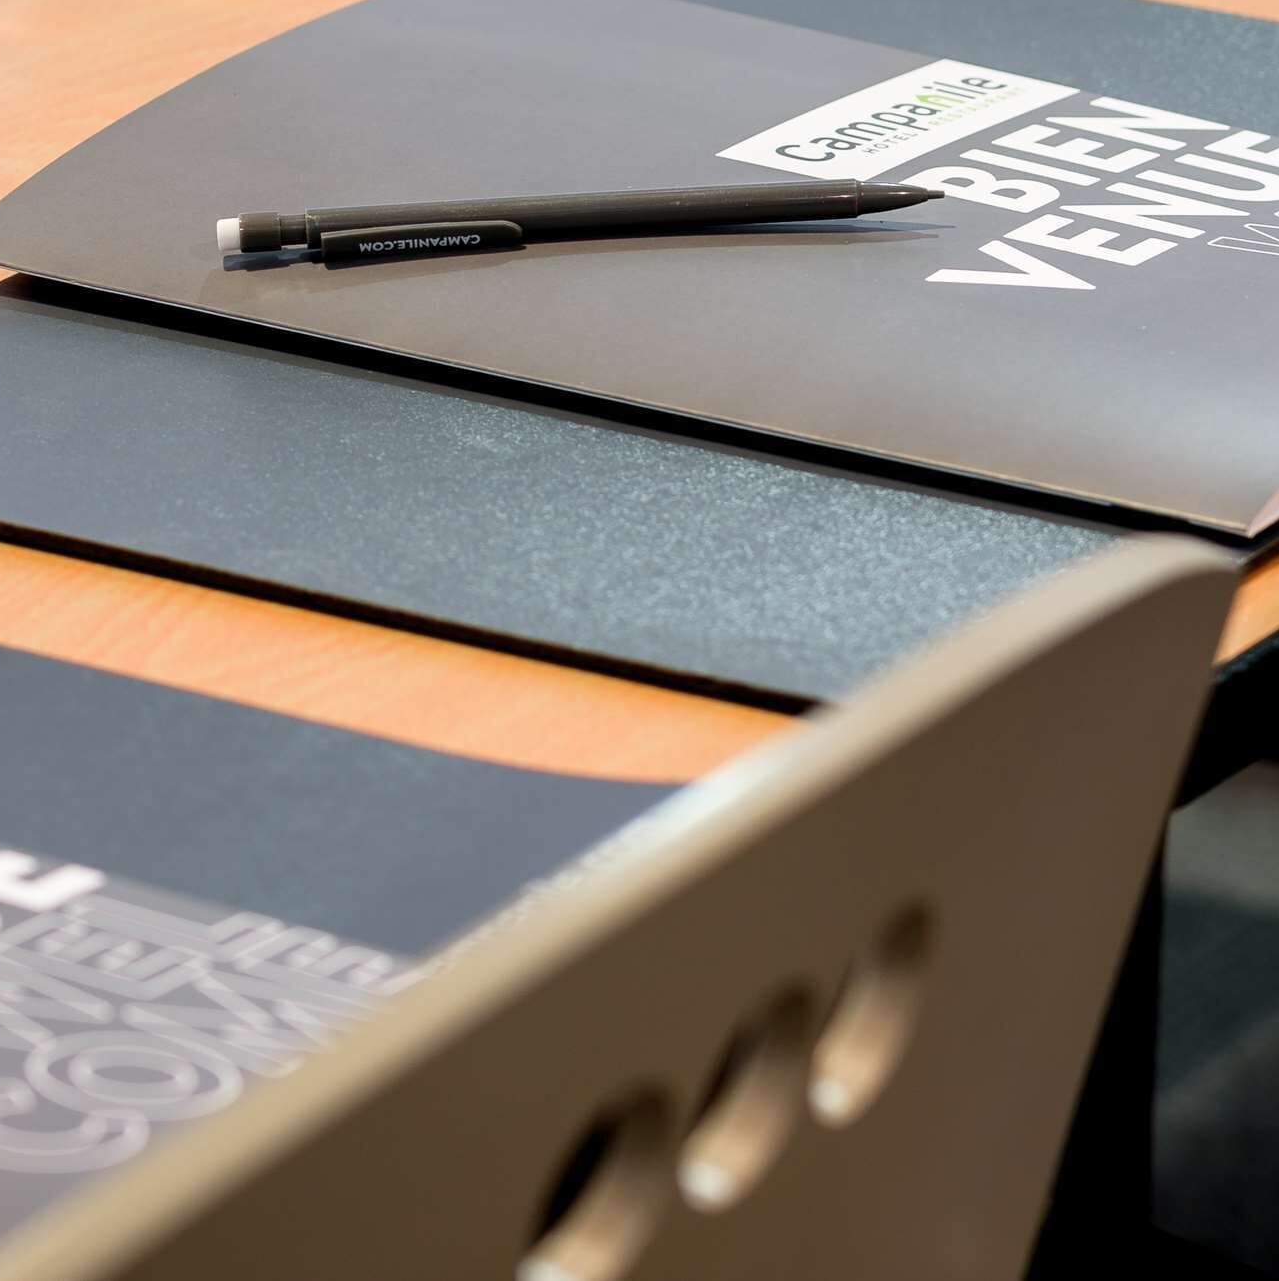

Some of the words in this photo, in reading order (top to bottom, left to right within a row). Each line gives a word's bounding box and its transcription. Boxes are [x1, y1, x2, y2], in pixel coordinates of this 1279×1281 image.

[775, 77, 1008, 162] Campanile
[861, 131, 920, 158] HOTEL
[898, 96, 1231, 214] BIEN
[359, 234, 481, 253] CAMPANILE.COM
